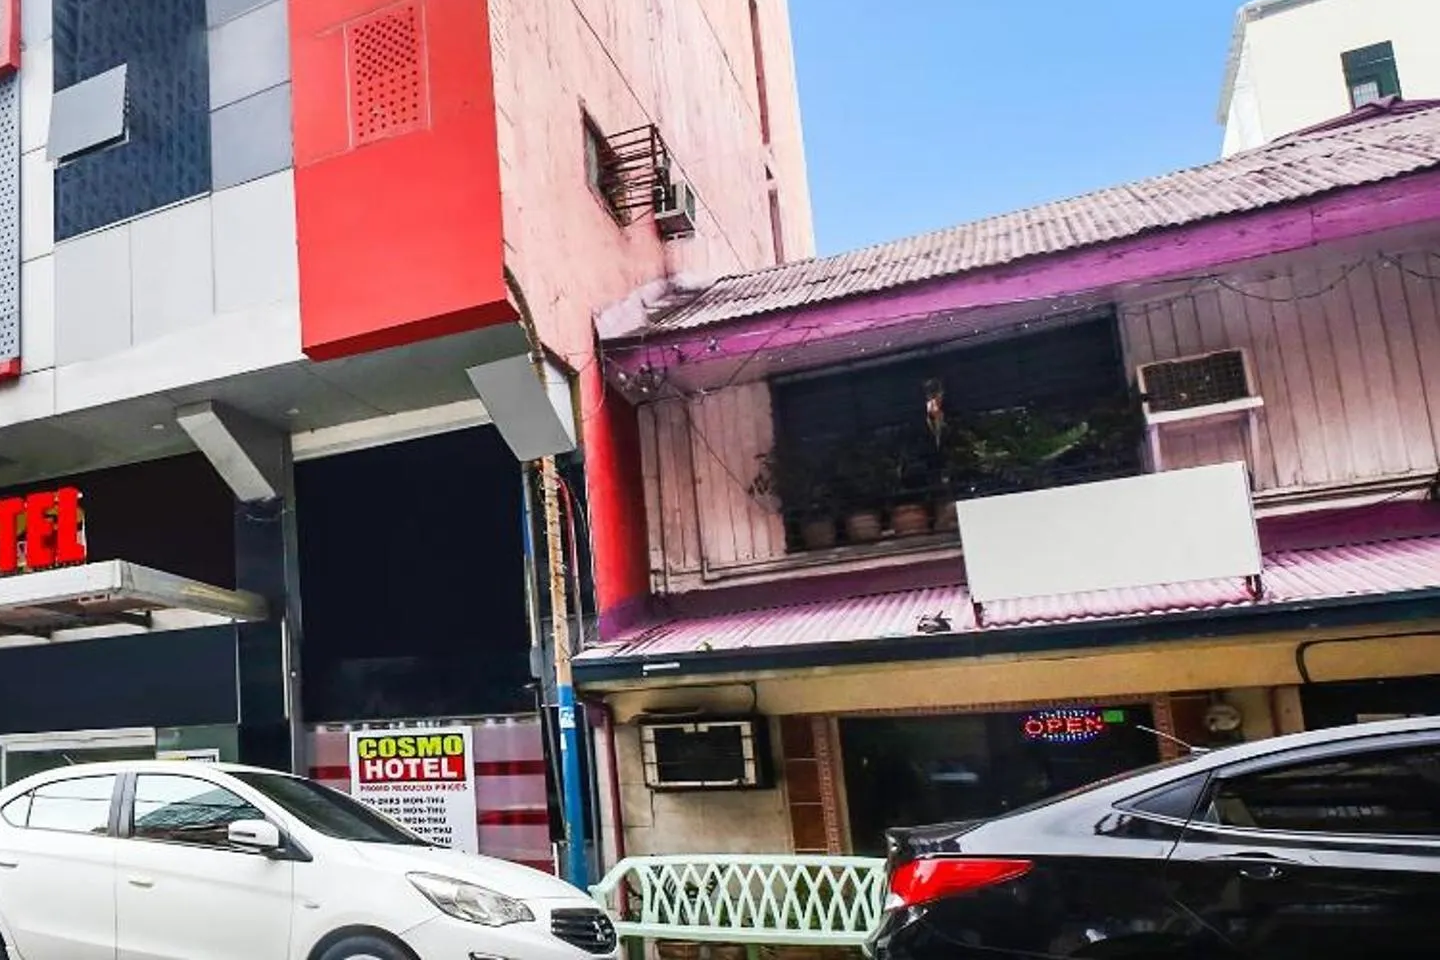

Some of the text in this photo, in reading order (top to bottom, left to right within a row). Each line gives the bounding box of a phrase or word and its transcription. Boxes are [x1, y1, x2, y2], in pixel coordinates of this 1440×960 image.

[1024, 716, 1105, 735] OPEN
[358, 735, 464, 759] COSMO
[364, 757, 458, 780] HOTEL
